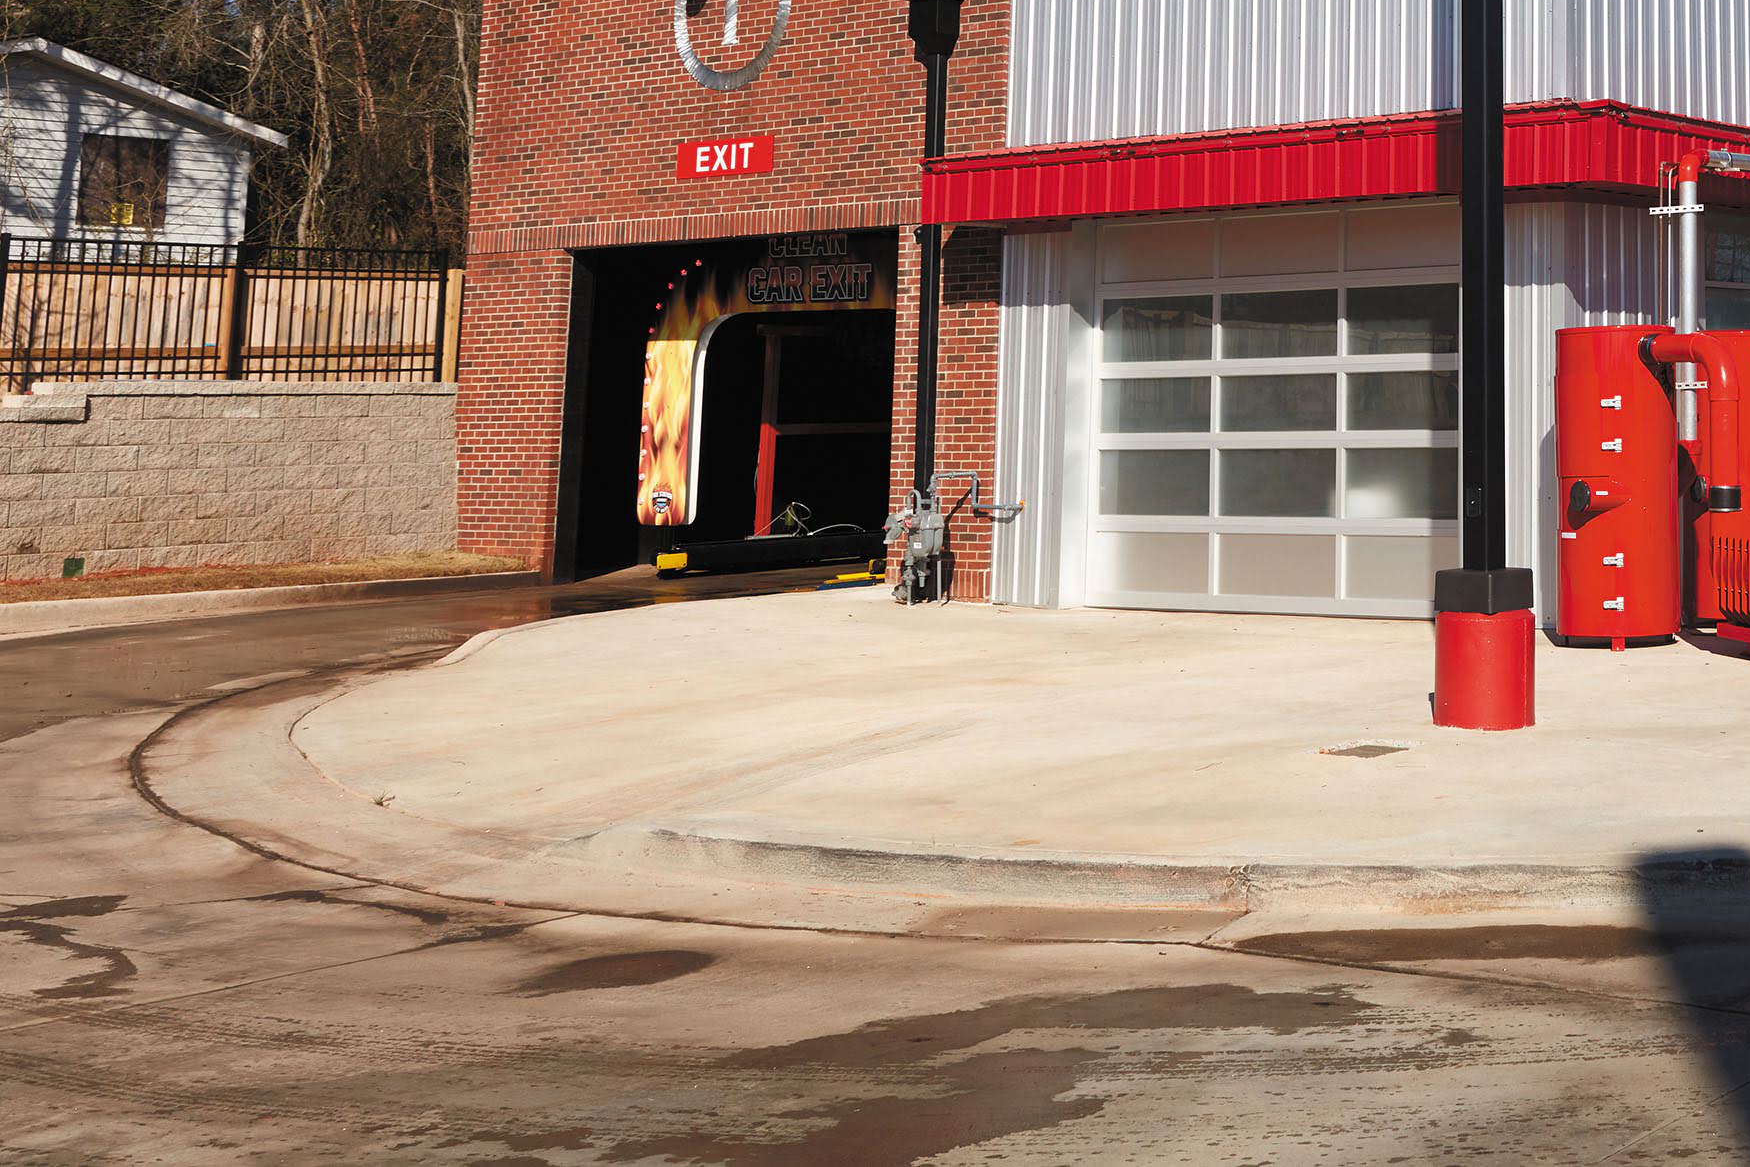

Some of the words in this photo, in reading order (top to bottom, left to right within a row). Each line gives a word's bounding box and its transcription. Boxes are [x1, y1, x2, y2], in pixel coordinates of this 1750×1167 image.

[695, 142, 754, 173] EXIT
[767, 233, 848, 258] CLEAN
[748, 267, 803, 302] CAR
[810, 263, 872, 301] EXIT
